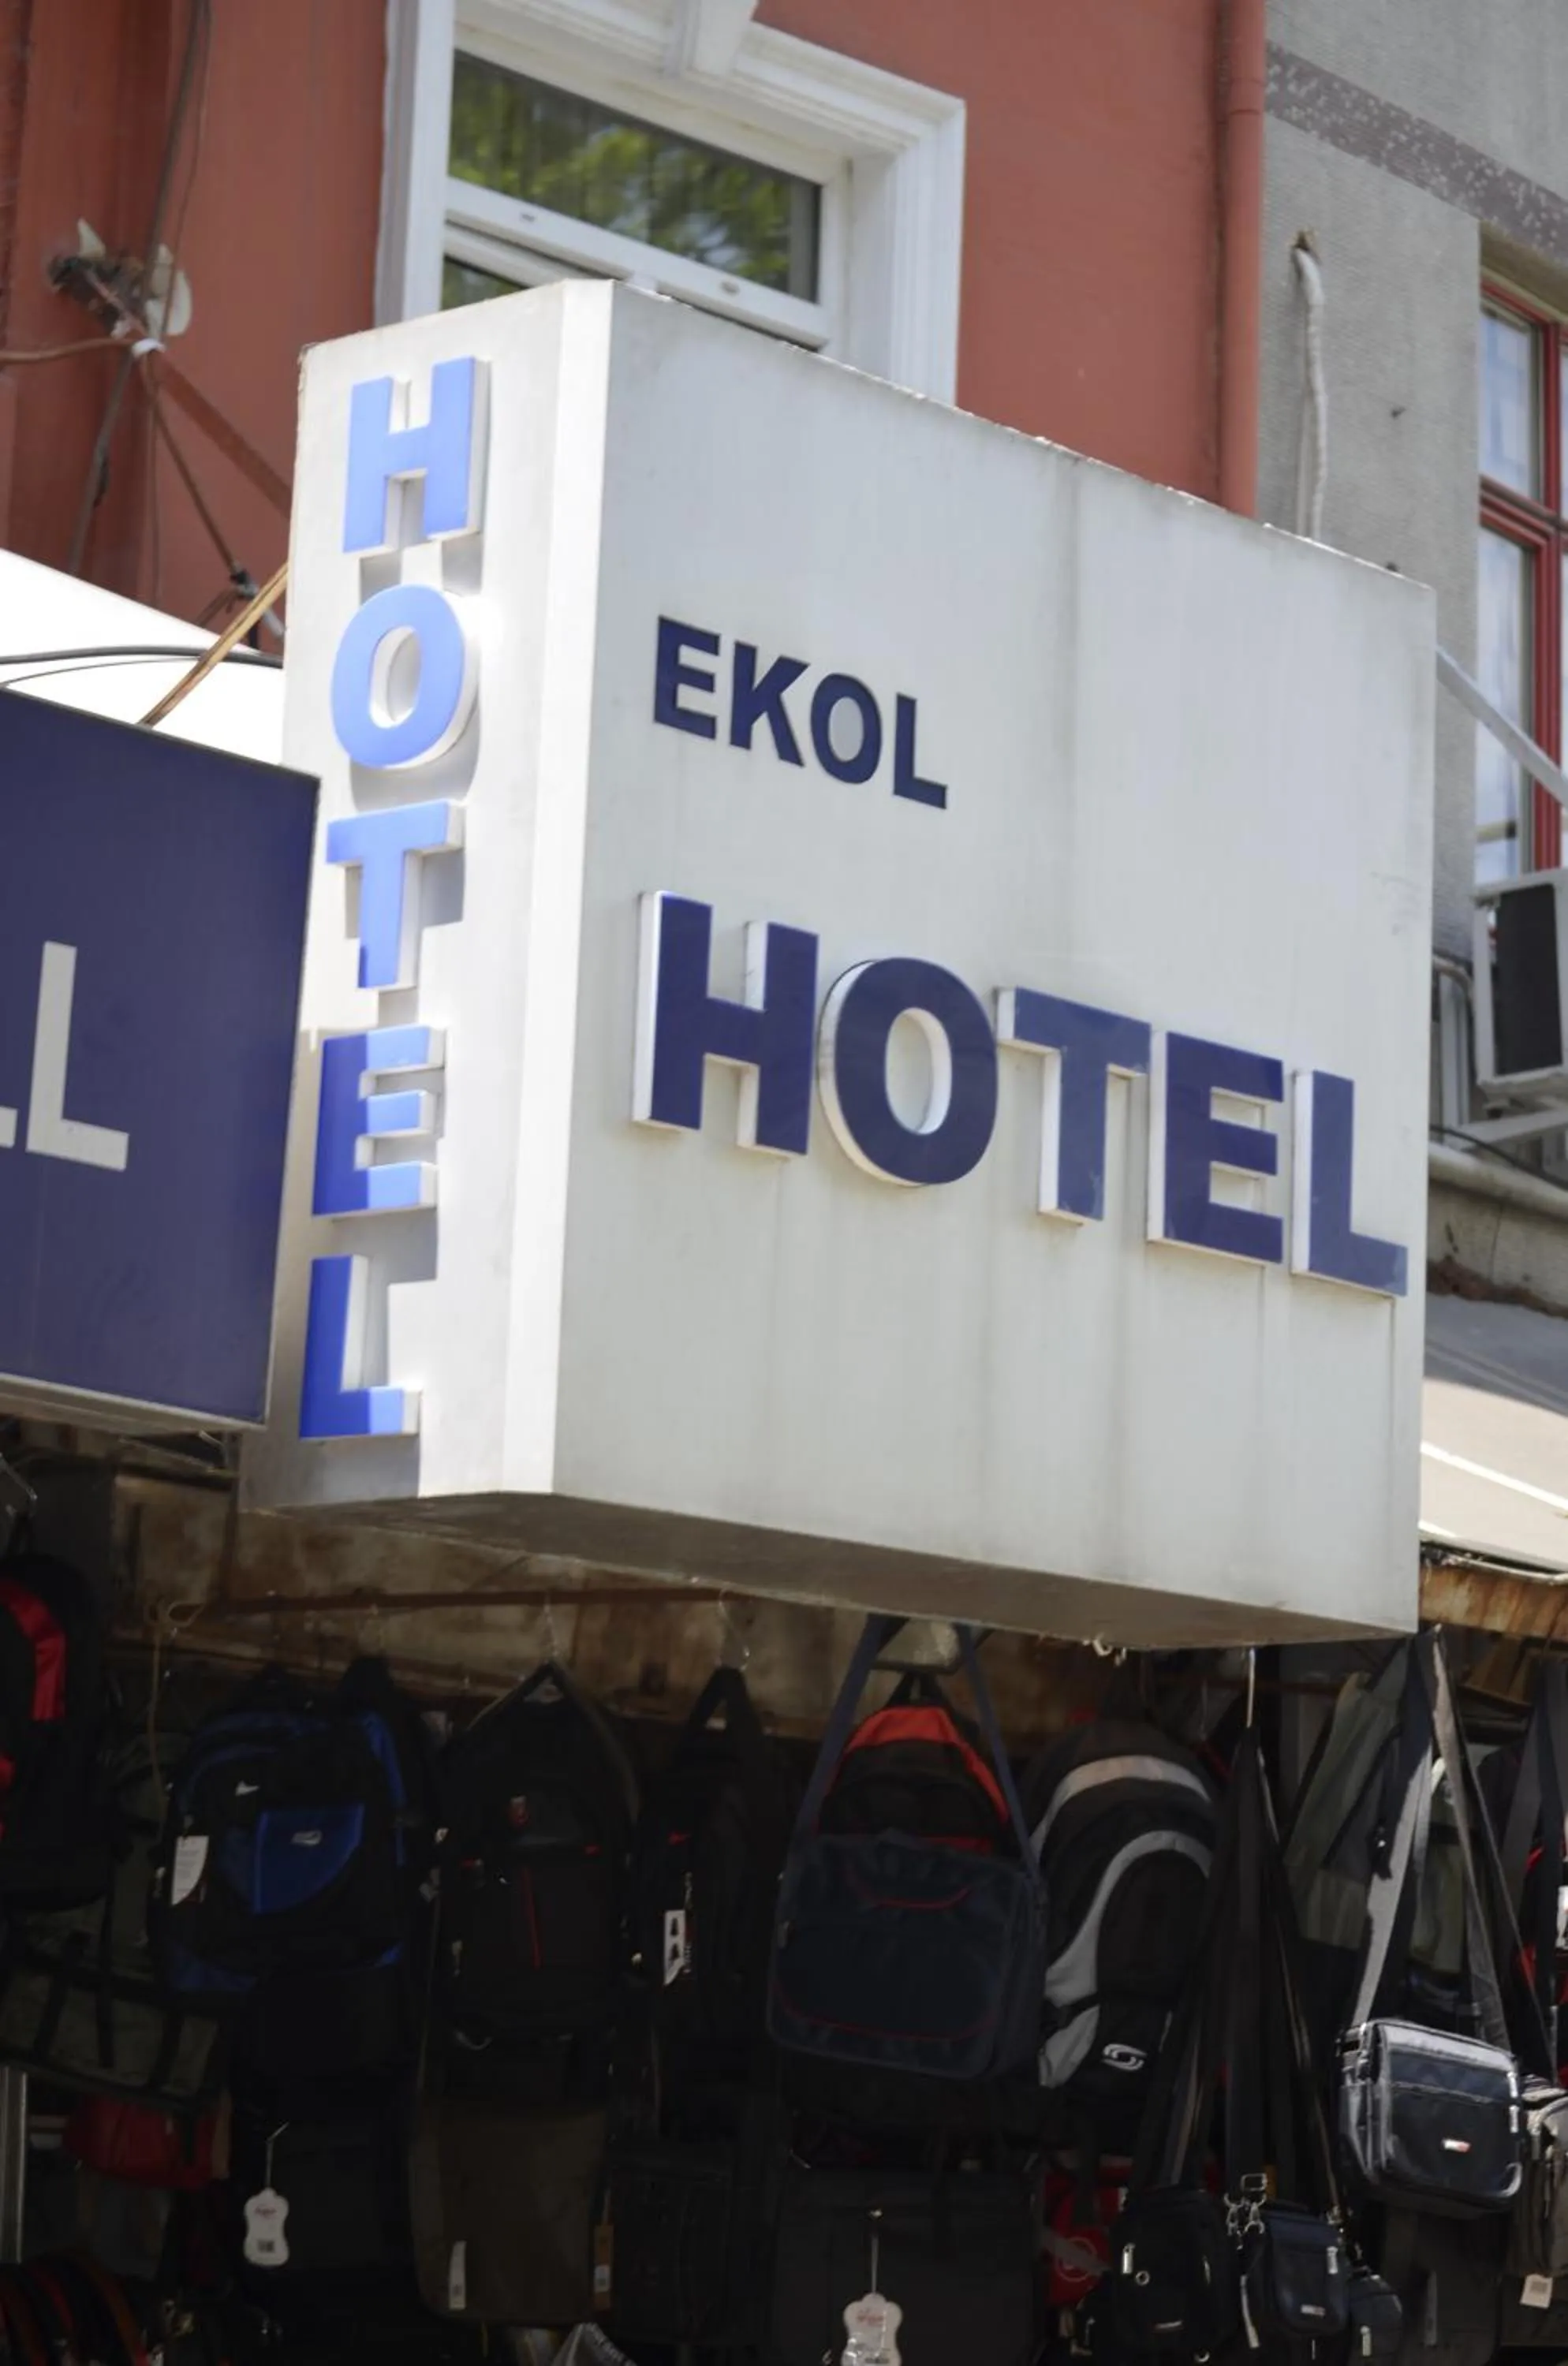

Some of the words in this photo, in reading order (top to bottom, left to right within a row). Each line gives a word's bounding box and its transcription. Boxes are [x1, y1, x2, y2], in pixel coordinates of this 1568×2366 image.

[655, 615, 948, 810] EKOL
[0, 941, 129, 1172] L
[300, 356, 491, 1440] HOTEL
[633, 888, 1408, 1297] HOTEL
